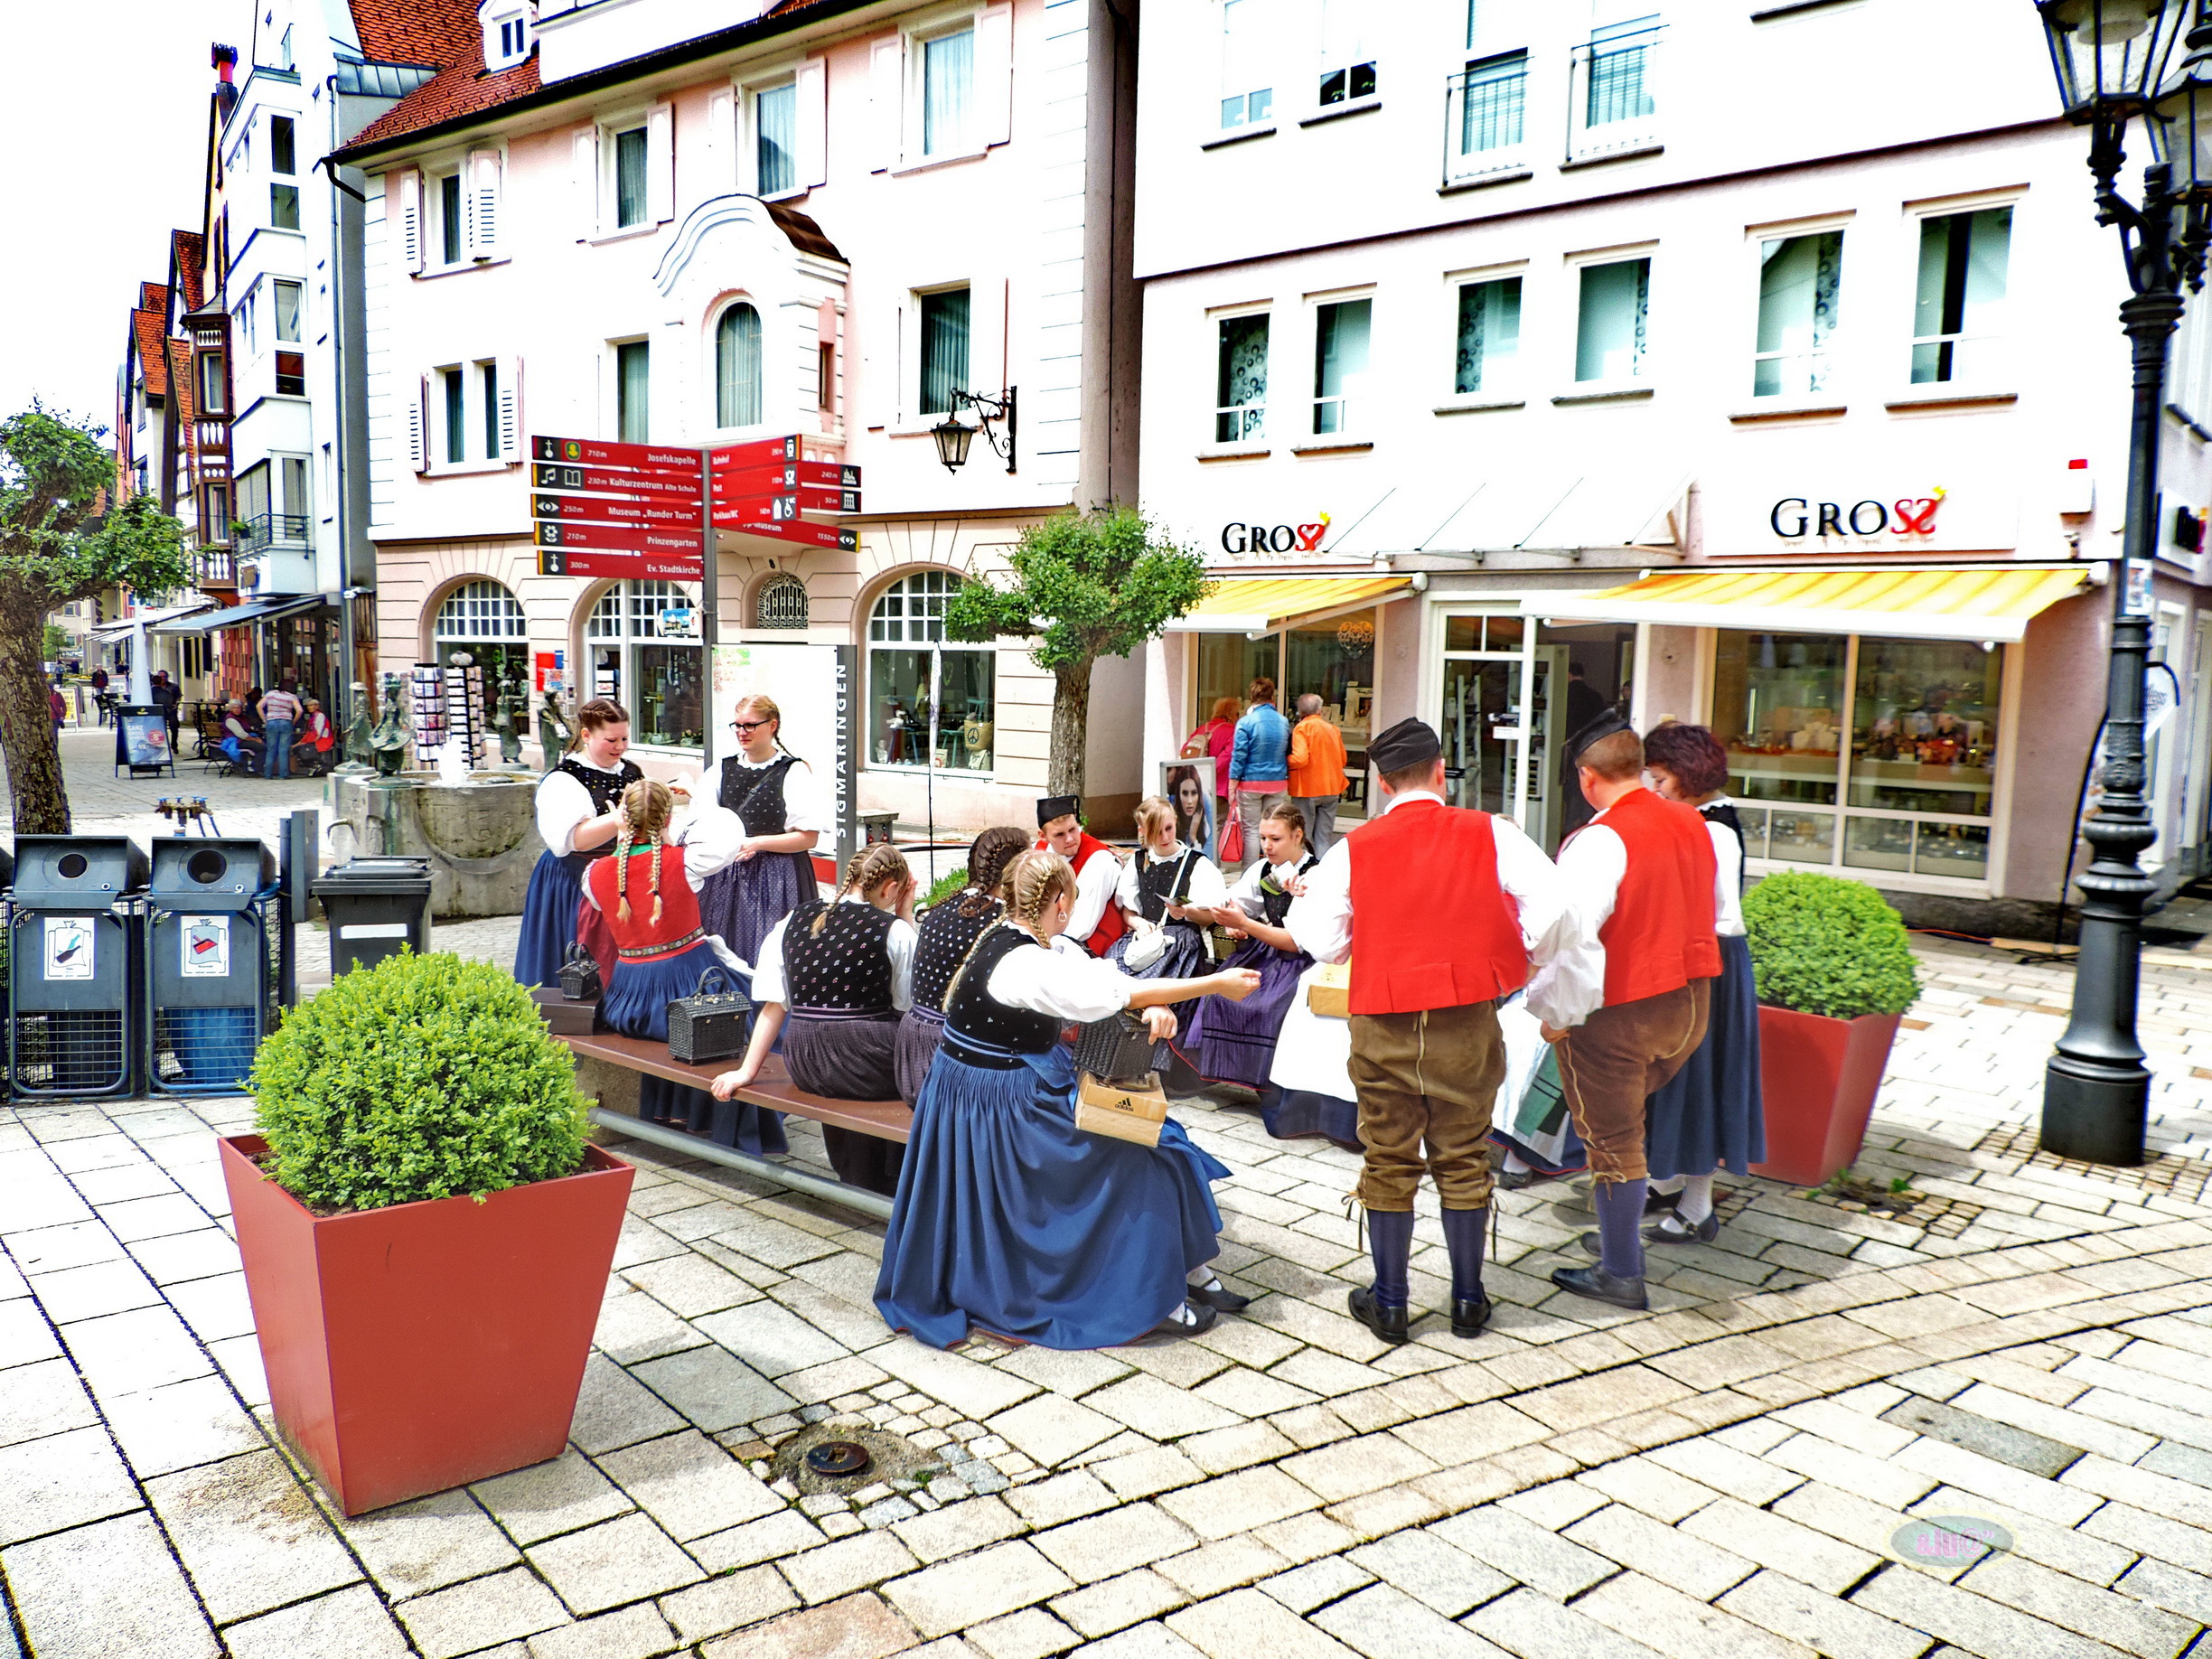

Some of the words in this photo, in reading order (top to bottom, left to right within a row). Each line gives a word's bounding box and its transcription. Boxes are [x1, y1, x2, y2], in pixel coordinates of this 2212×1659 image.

[647, 454, 697, 466] Josefskapelle
[609, 478, 663, 490] Kulturzentrum
[608, 507, 641, 518] Museum
[647, 536, 698, 548] Prinzengarten
[768, 558, 776, 569] 8
[647, 564, 659, 572] Ev.
[659, 565, 700, 575] Stadtkirche
[837, 665, 848, 838] SIGMARINGEN
[1115, 1103, 1134, 1111] adidas
